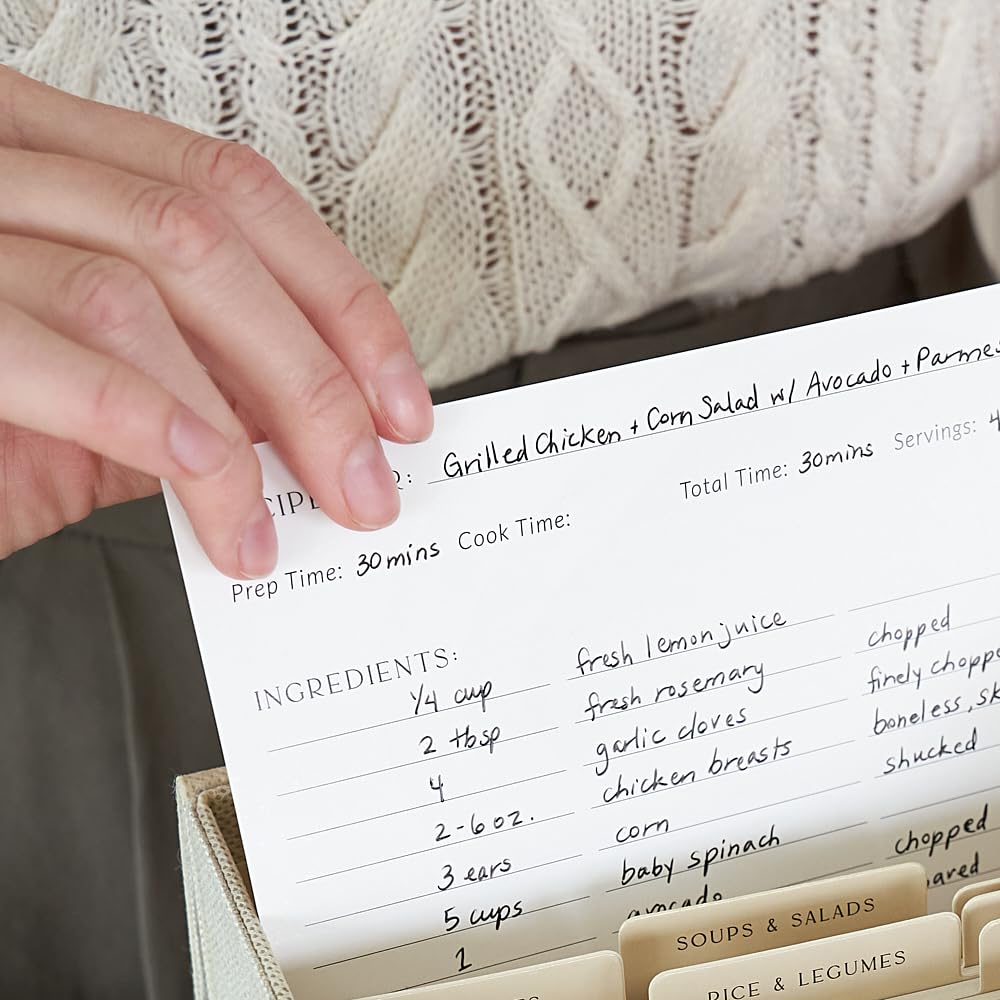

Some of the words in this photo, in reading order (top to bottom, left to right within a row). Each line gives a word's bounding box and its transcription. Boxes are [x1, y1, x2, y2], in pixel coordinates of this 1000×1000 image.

[443, 436, 528, 479] Grilled
[536, 426, 621, 454] Chicken
[630, 419, 639, 436] +
[647, 407, 693, 431] Corn
[699, 384, 758, 419] Salad
[770, 379, 795, 406] w/
[806, 358, 892, 397] Avocado
[901, 359, 911, 375] +
[893, 418, 977, 452] Servings:
[680, 473, 728, 500] Total
[735, 463, 788, 488] Time:
[458, 525, 509, 550] Cook
[515, 513, 571, 537] Time:
[231, 582, 278, 603] Prep
[285, 565, 343, 592] Time:
[576, 647, 633, 675] fresh
[646, 634, 713, 658] lemon
[717, 612, 787, 649] juice
[868, 602, 951, 651] chopped
[254, 648, 458, 711] INGREDIENTS:
[454, 681, 492, 712] cup
[584, 692, 641, 721] fresh
[655, 663, 764, 694] rosemary
[867, 662, 922, 694] finely
[418, 736, 436, 755] 2
[449, 724, 500, 754] tbsp
[595, 726, 666, 777] garlic
[678, 707, 747, 740] cloves
[883, 727, 978, 775] shucked
[429, 775, 445, 802] 4
[603, 768, 695, 804] chicken
[708, 736, 794, 775] breasts
[615, 816, 669, 844] corn
[895, 802, 988, 857] chopped
[621, 857, 674, 887] baby
[688, 824, 781, 876] spinach
[926, 851, 979, 887] ared
[437, 864, 454, 891] 3
[464, 859, 511, 882] ears
[445, 904, 460, 932] 5
[469, 900, 523, 931] cups
[676, 922, 753, 951] SOUPS
[767, 918, 778, 933] &
[791, 897, 876, 929] SALADS
[455, 947, 473, 972] 1
[773, 976, 786, 993] &
[798, 950, 906, 988] LEGUMES
